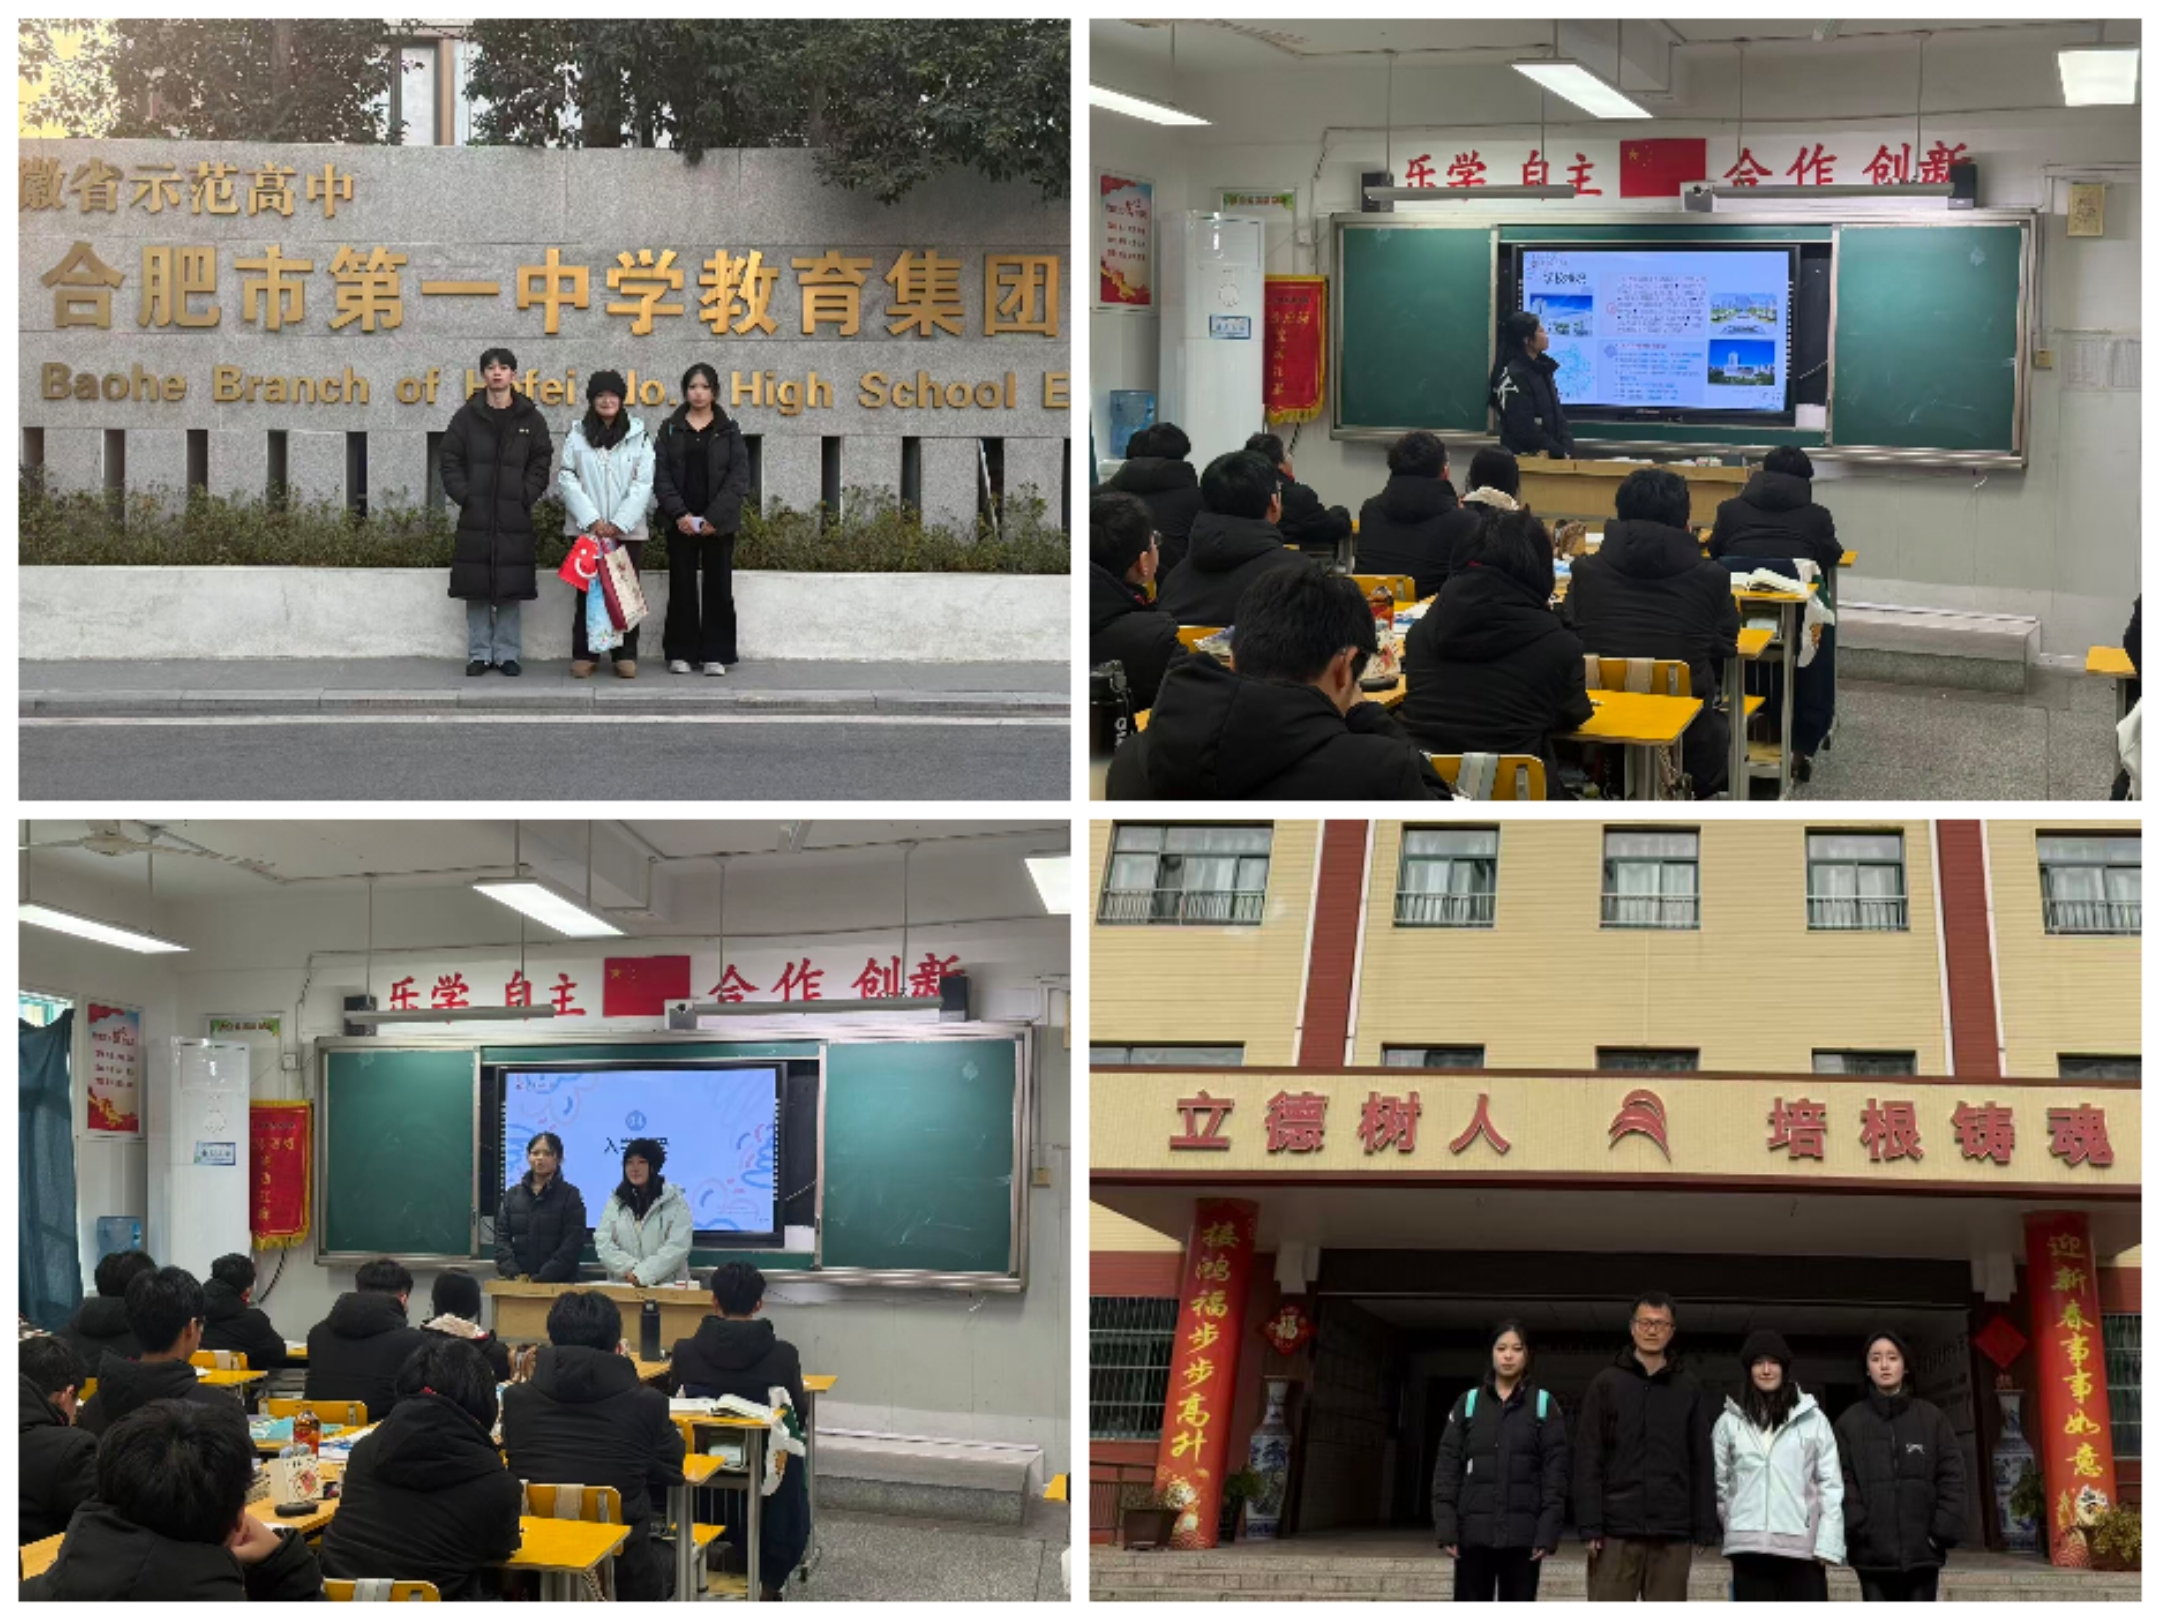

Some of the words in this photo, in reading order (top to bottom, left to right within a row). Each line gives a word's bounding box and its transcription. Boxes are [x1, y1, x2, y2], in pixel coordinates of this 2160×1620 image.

[1521, 149, 1603, 196] 自主
[1723, 143, 1838, 188] 合作
[1872, 140, 1975, 185] 创新
[41, 240, 1061, 336] 合肥市第一中学教育集团
[41, 362, 188, 402] Baohe
[213, 364, 370, 405] Branch
[395, 368, 440, 405] of
[464, 368, 576, 406] Hfei
[731, 370, 832, 415] High
[858, 370, 1017, 408] School
[505, 969, 587, 1016] 自主
[708, 957, 825, 1003] 合作
[851, 953, 966, 998] 创新
[1169, 1090, 1512, 1155] 立德树人
[1767, 1098, 2114, 1168] 培根铸魂
[1171, 1221, 1240, 1463] 接鸿福步步高升
[2047, 1233, 2104, 1479] 迎新春事事如意
